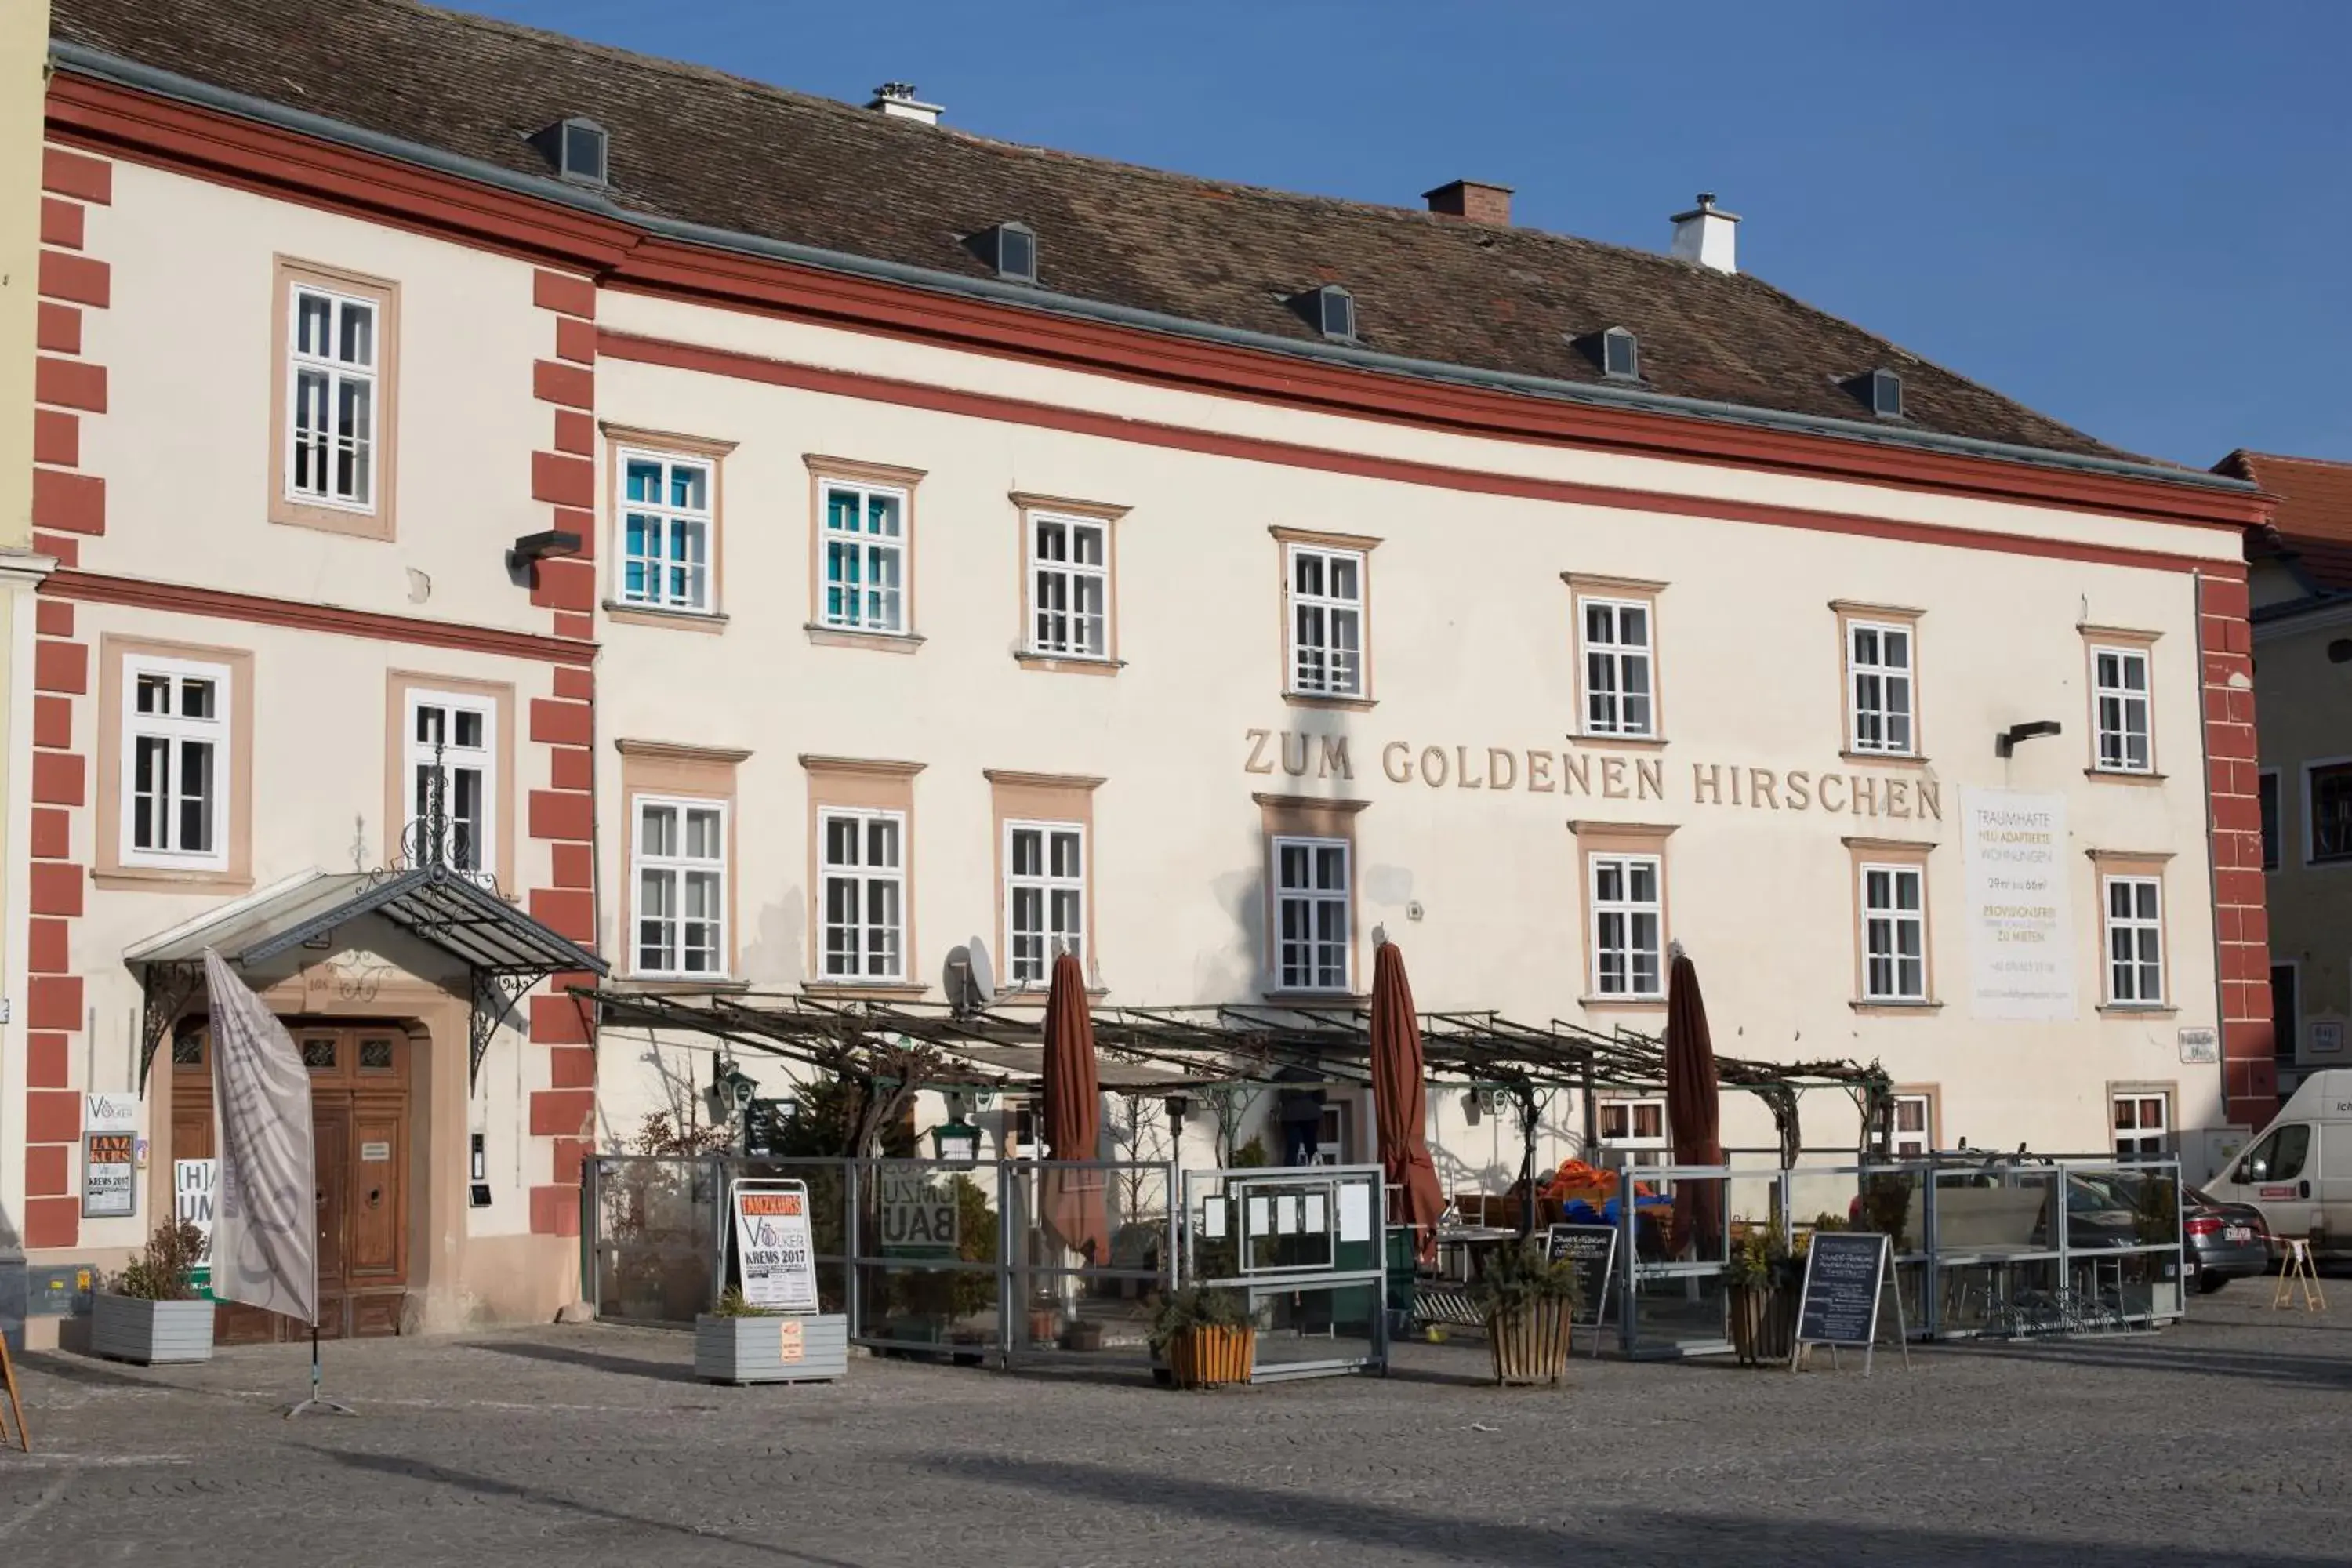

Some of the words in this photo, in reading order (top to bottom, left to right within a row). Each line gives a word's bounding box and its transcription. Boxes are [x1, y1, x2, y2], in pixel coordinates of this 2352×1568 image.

[1245, 728, 1354, 780] ZUM
[1382, 740, 1664, 800] GOLDENEN
[1693, 763, 1943, 821] HIRSCHEN
[1976, 810, 2052, 828] TRAUMHAFTE
[1978, 831, 1998, 843] NEU
[1981, 848, 2053, 863] WOHNUNGEN
[740, 1195, 802, 1215] TANZKURS
[744, 1250, 780, 1265] KREMS
[782, 1249, 805, 1263] 2017
